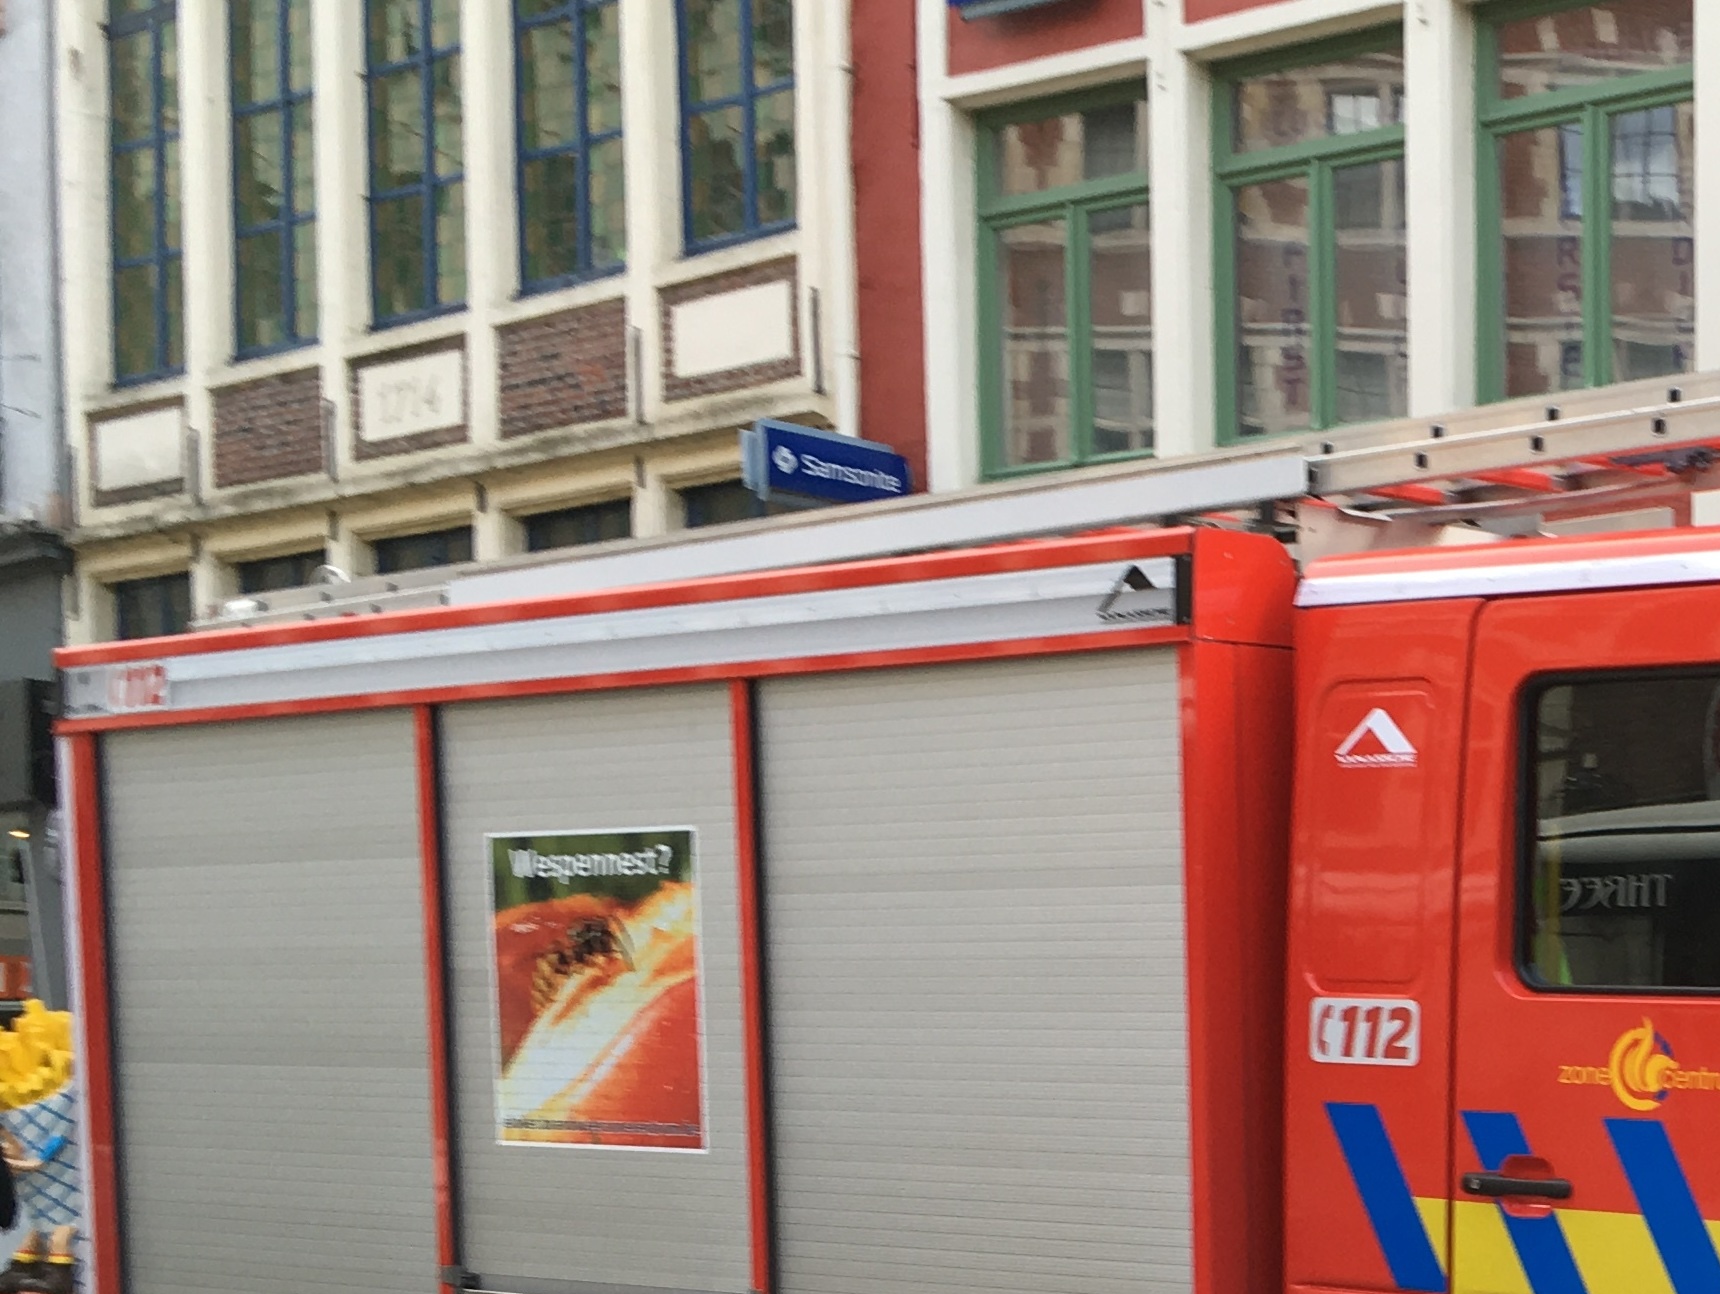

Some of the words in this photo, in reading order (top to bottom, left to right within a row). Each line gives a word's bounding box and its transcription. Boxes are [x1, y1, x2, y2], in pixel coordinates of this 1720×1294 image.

[801, 453, 902, 494] Samsonite
[508, 844, 672, 884] Wespennest?
[1340, 1005, 1412, 1059] 112
[1557, 1065, 1611, 1086] zone
